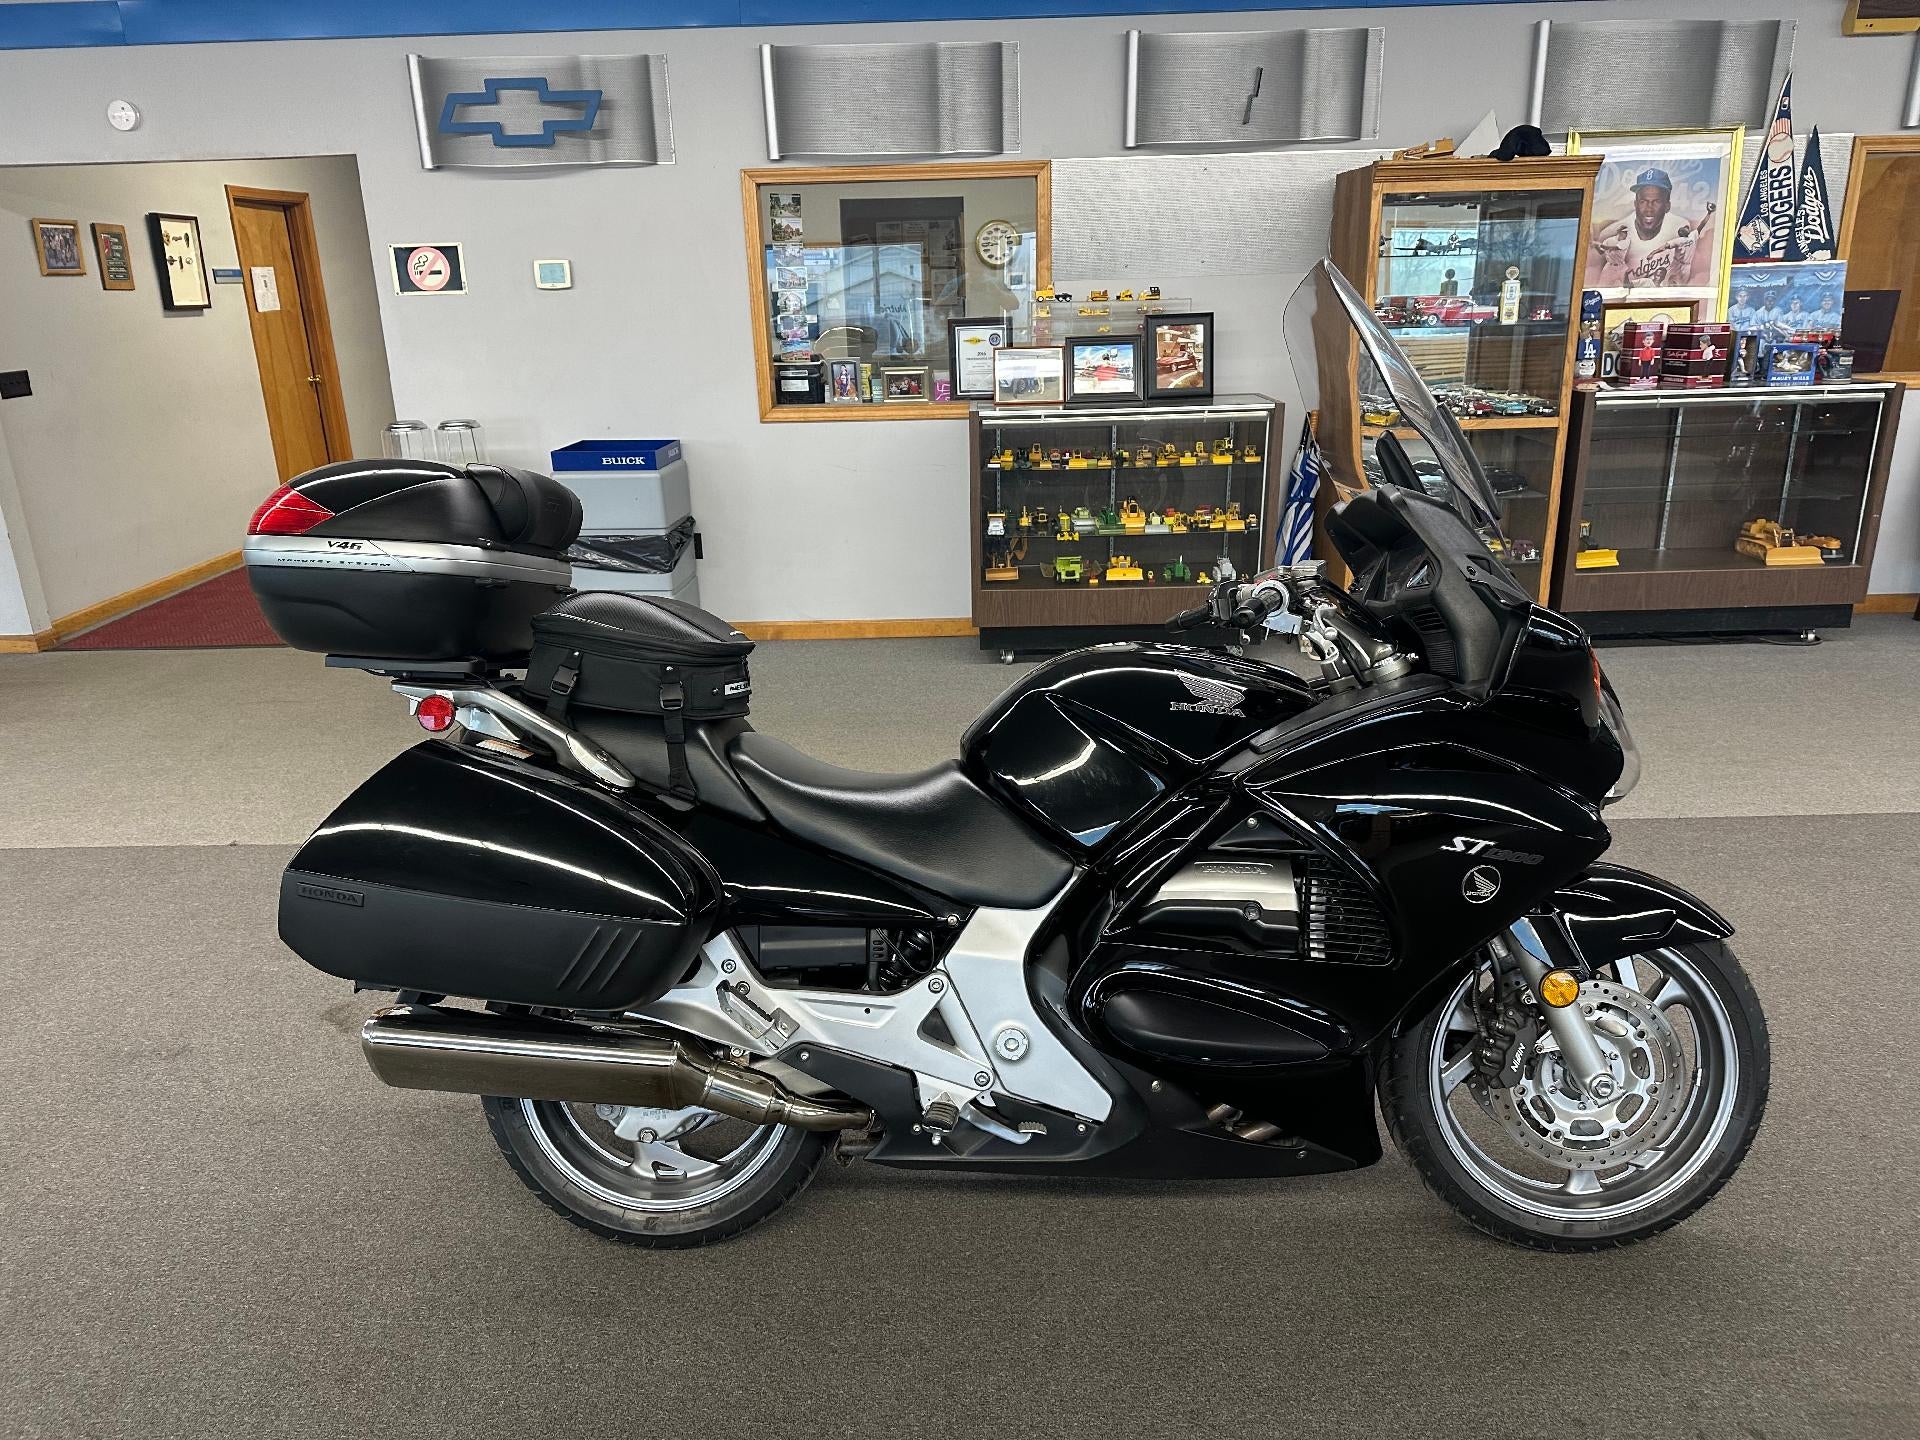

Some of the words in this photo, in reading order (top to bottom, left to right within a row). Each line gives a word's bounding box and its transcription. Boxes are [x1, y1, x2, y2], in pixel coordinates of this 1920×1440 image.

[1760, 169, 1768, 199] ANGELES
[1760, 200, 1769, 217] LOS
[1769, 165, 1793, 252] DODGERS
[1802, 166, 1830, 244] Dodgers
[1584, 337, 1597, 358] LA
[602, 456, 645, 465] BUICK
[327, 540, 363, 550] V46
[1169, 701, 1247, 718] HONDA
[1440, 836, 1498, 855] ST
[1201, 864, 1268, 876] HONDA
[300, 885, 360, 905] HONDA
